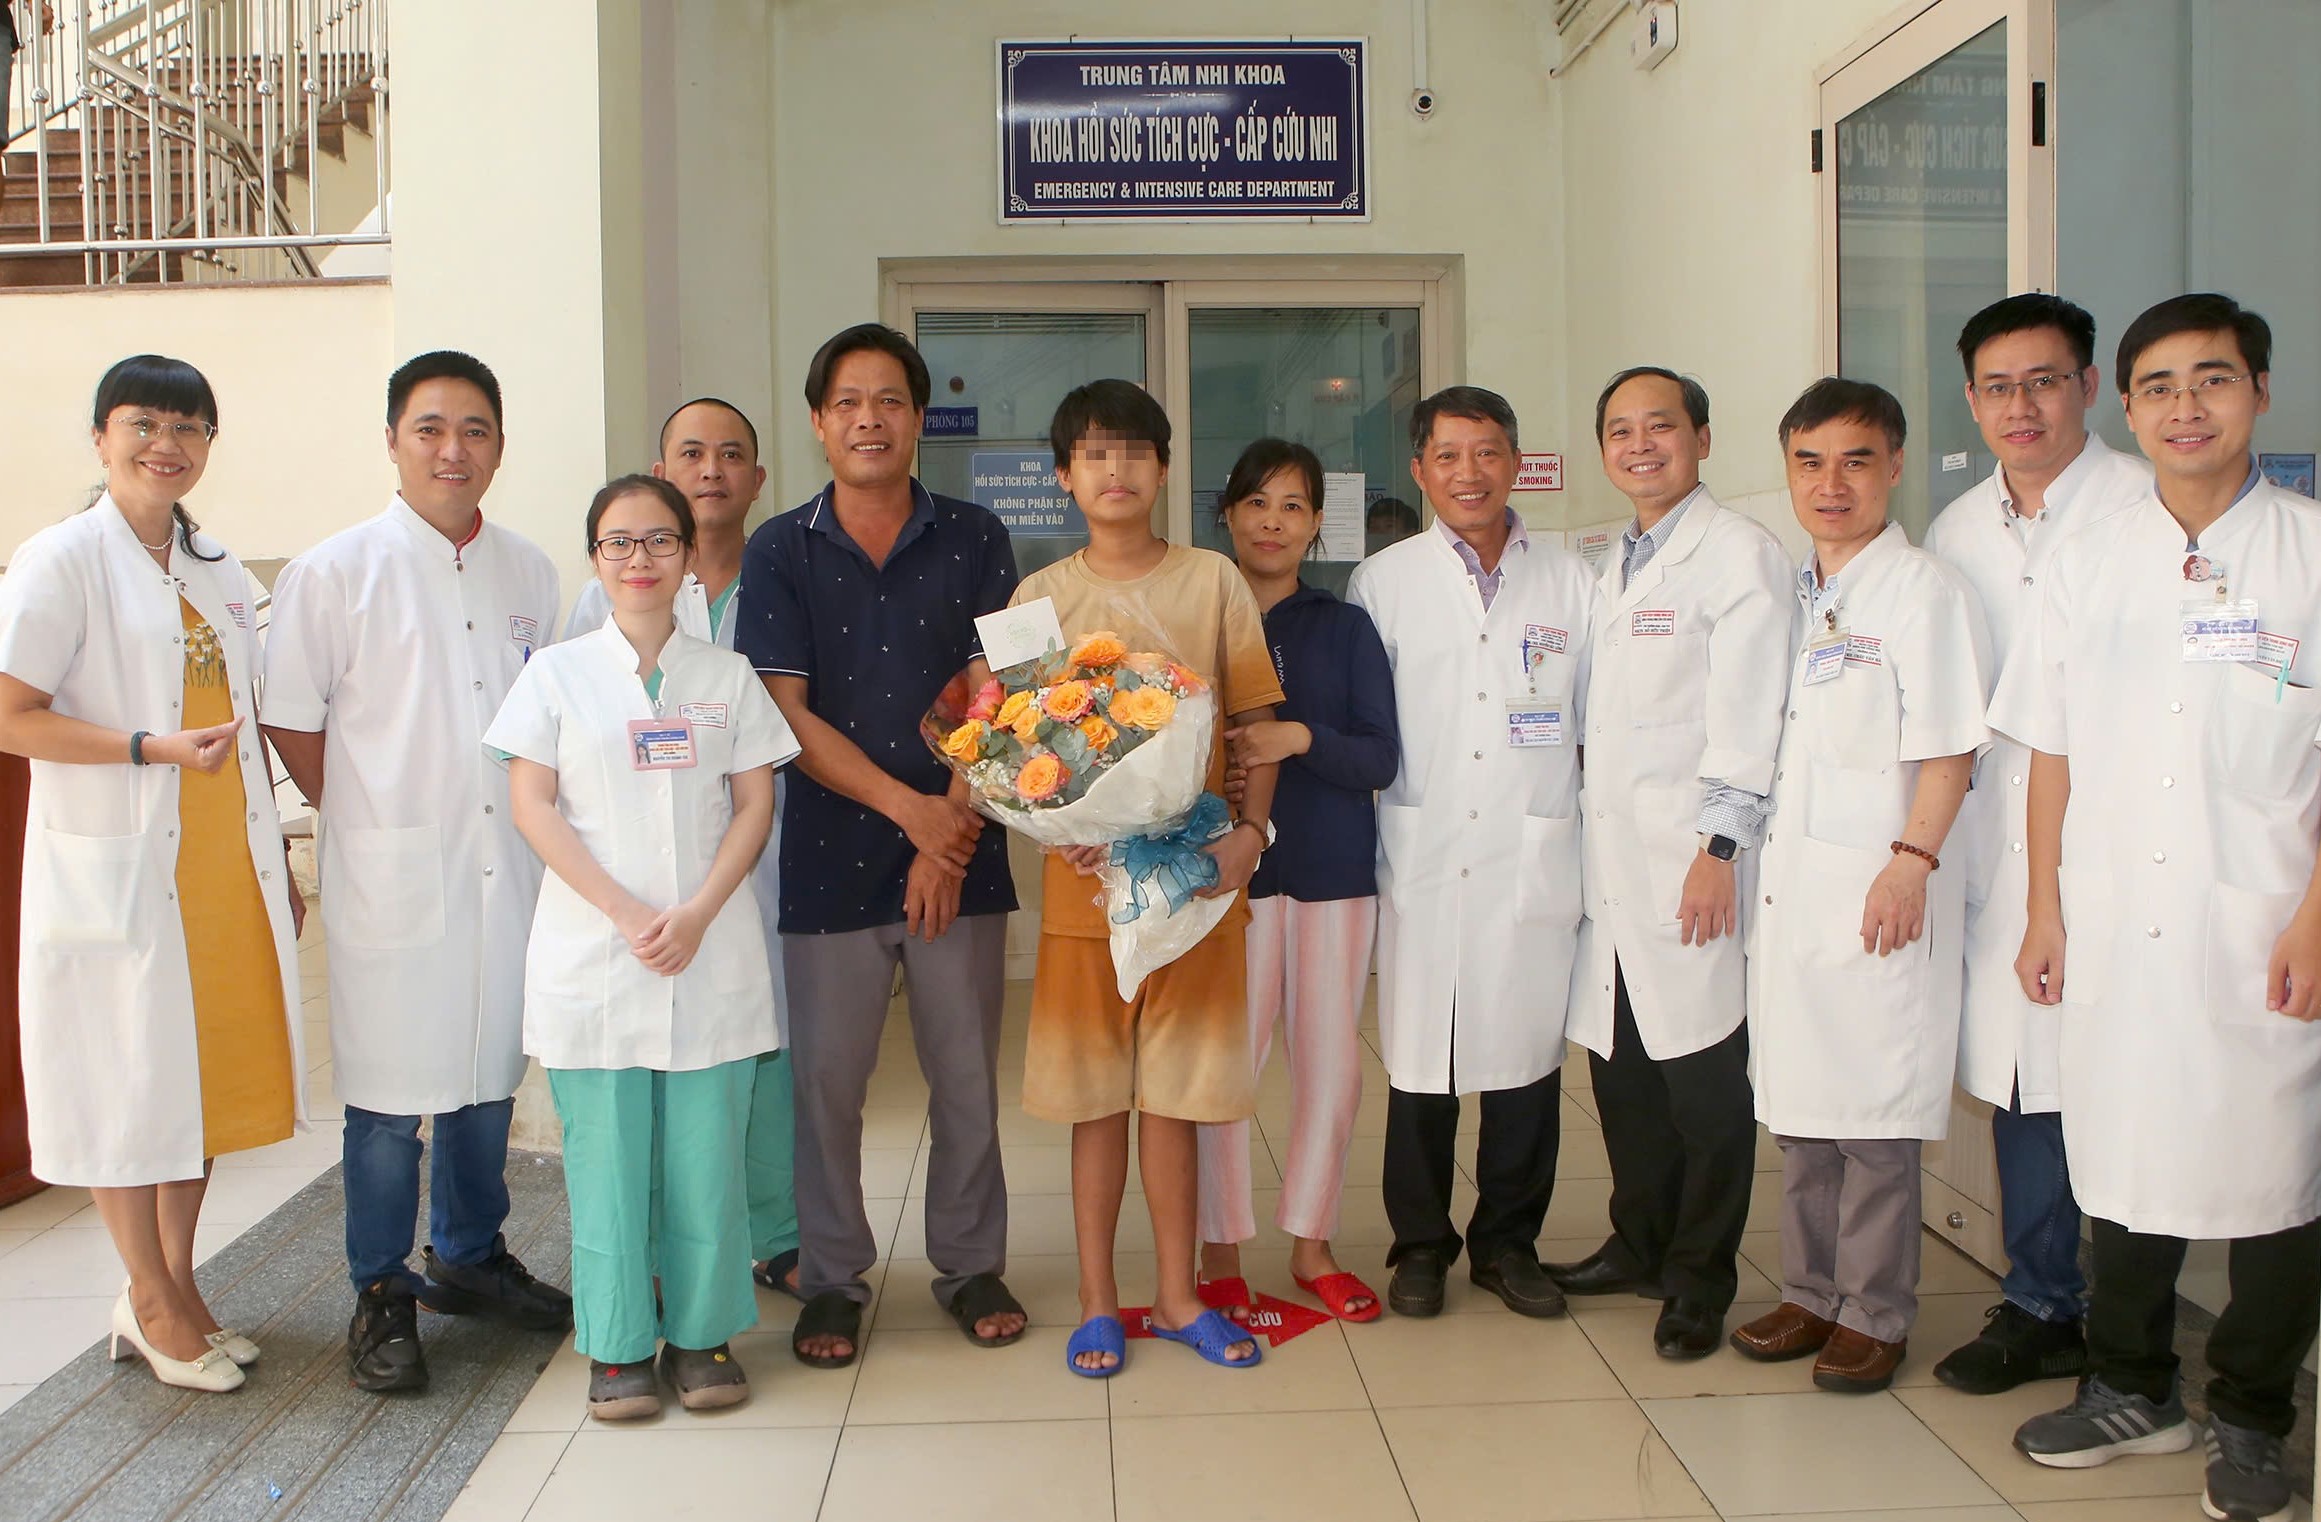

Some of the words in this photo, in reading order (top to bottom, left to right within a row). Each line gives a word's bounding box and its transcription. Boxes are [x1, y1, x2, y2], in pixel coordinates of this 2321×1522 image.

[1080, 65, 1142, 85] TRUNG
[1148, 61, 1189, 85] TÂM
[1196, 65, 1228, 85] NHI
[1235, 65, 1286, 85] KHOA
[1030, 117, 1073, 163] KHOA
[1078, 101, 1105, 163] HỒI
[1110, 107, 1142, 163] SỨC
[1146, 106, 1182, 163] TÍCH
[1187, 112, 1219, 172] CỰC
[1224, 138, 1231, 147] -
[1235, 100, 1268, 162] CẤP
[1273, 106, 1305, 162] CỨU
[1309, 116, 1337, 161] NHI
[1034, 182, 1116, 199] EMERGENCY
[1120, 182, 1131, 198] &
[1135, 181, 1204, 198] INTENSIVE
[1208, 181, 1243, 198] CARE
[1247, 180, 1335, 198] DEPARTMENT
[926, 412, 958, 429] PHÒNG
[961, 415, 975, 428] 105
[1020, 461, 1042, 472] KHOA
[1535, 459, 1558, 472] THUỐC
[989, 472, 1004, 487] SỨC
[1005, 474, 1021, 487] TÍCH
[1023, 474, 1037, 489] CỰC
[1519, 476, 1553, 486] SMOKING
[993, 496, 1026, 509] KHÔNG
[1028, 496, 1054, 511] PHẬN
[1055, 497, 1069, 511] SỰ
[1000, 514, 1017, 526] XIN
[1046, 512, 1064, 526] VÀO
